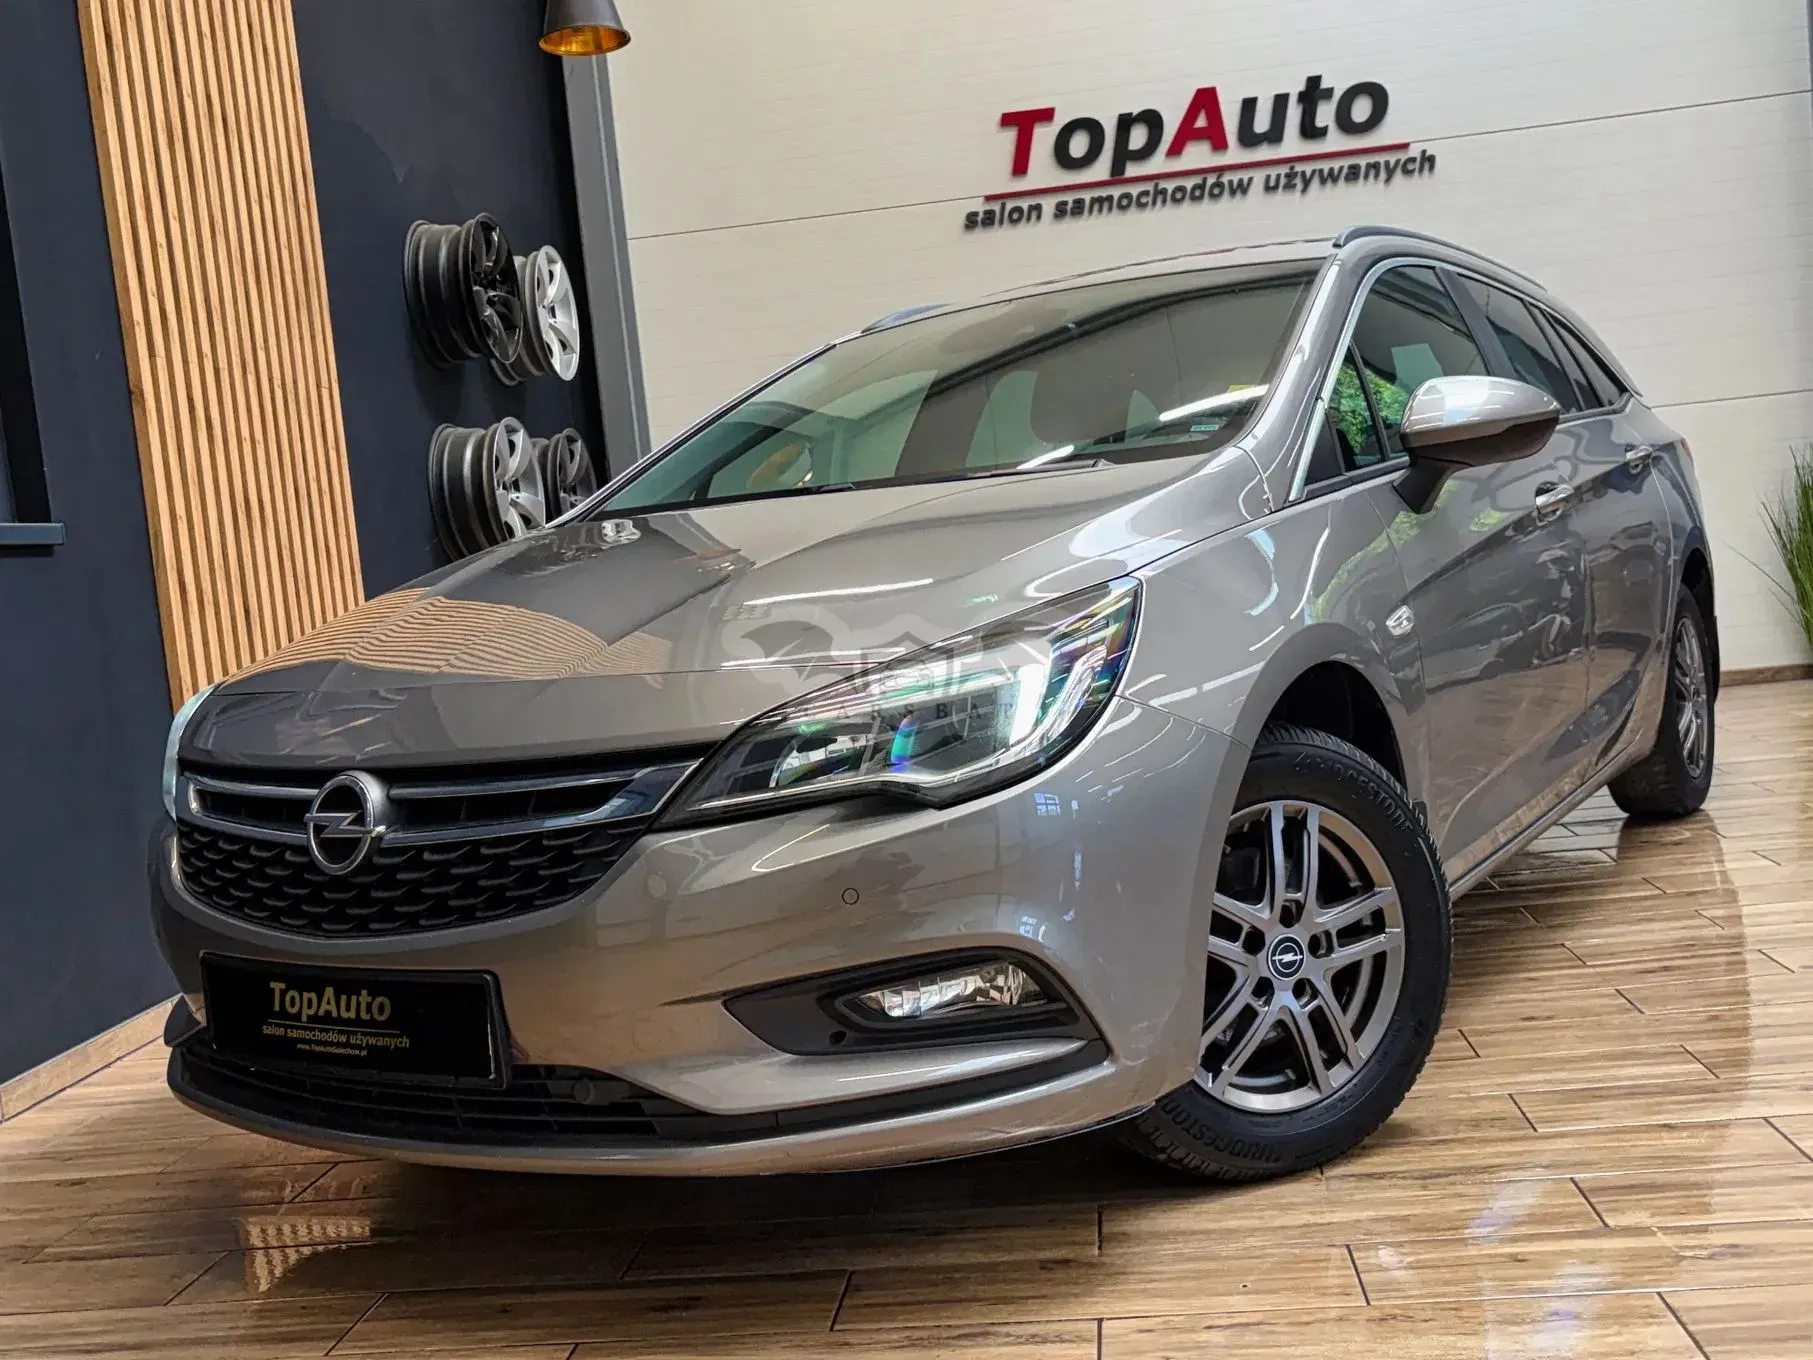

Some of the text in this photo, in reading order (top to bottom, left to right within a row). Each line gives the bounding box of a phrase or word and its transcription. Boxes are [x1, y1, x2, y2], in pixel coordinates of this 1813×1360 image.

[1000, 75, 1390, 178] TopAuto
[963, 149, 1437, 231] salon samochodów używanych
[269, 981, 391, 1021] TopAuto
[262, 1024, 410, 1048] salon samochodów używanych
